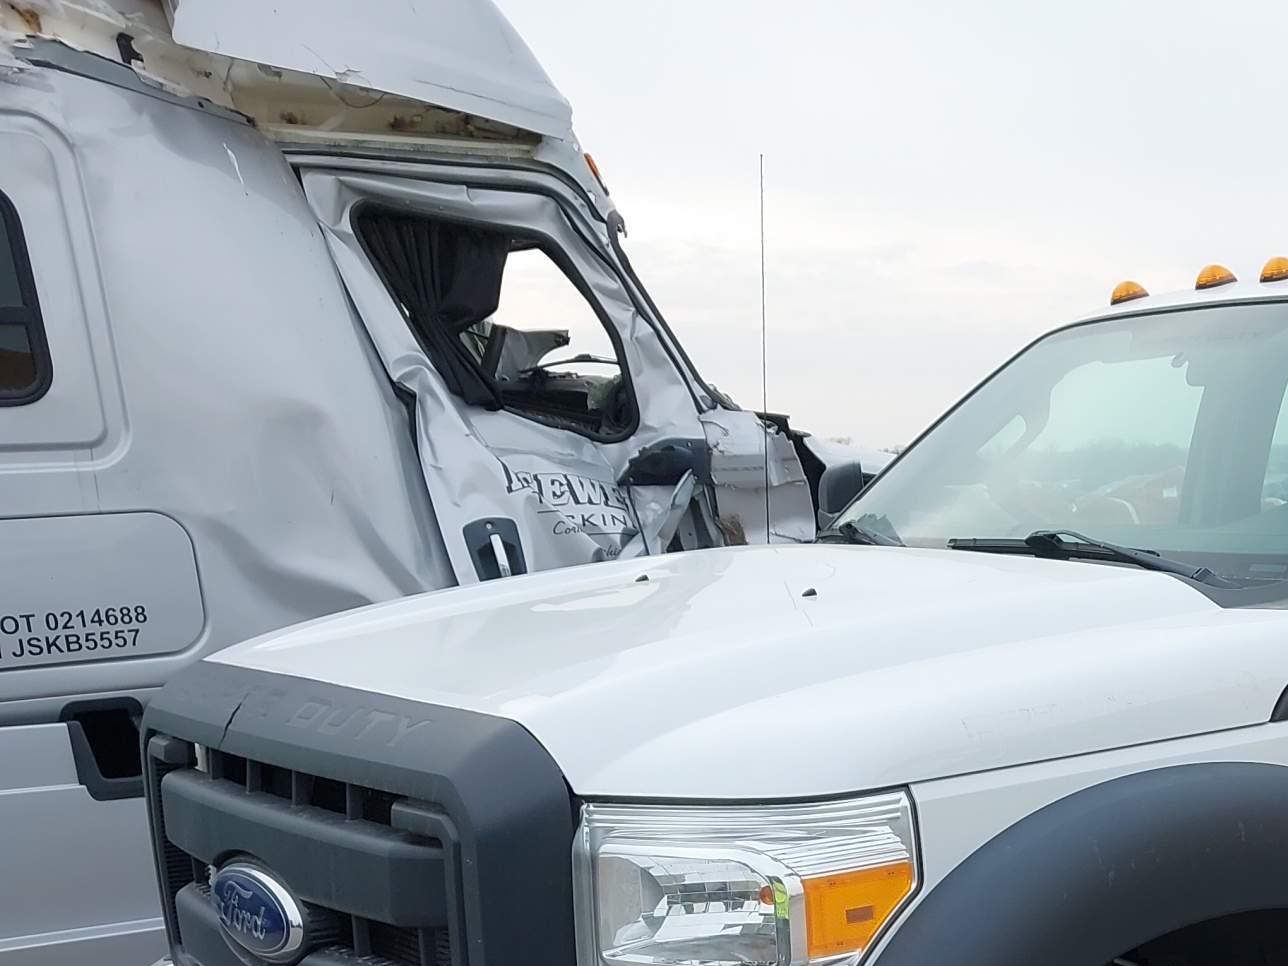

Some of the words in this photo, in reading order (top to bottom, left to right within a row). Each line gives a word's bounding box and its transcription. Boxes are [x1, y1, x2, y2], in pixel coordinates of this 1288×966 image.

[45, 605, 148, 632] 0214688
[12, 628, 140, 658] JSKB5557
[285, 698, 433, 748] DUTY
[219, 880, 267, 940] Ford
